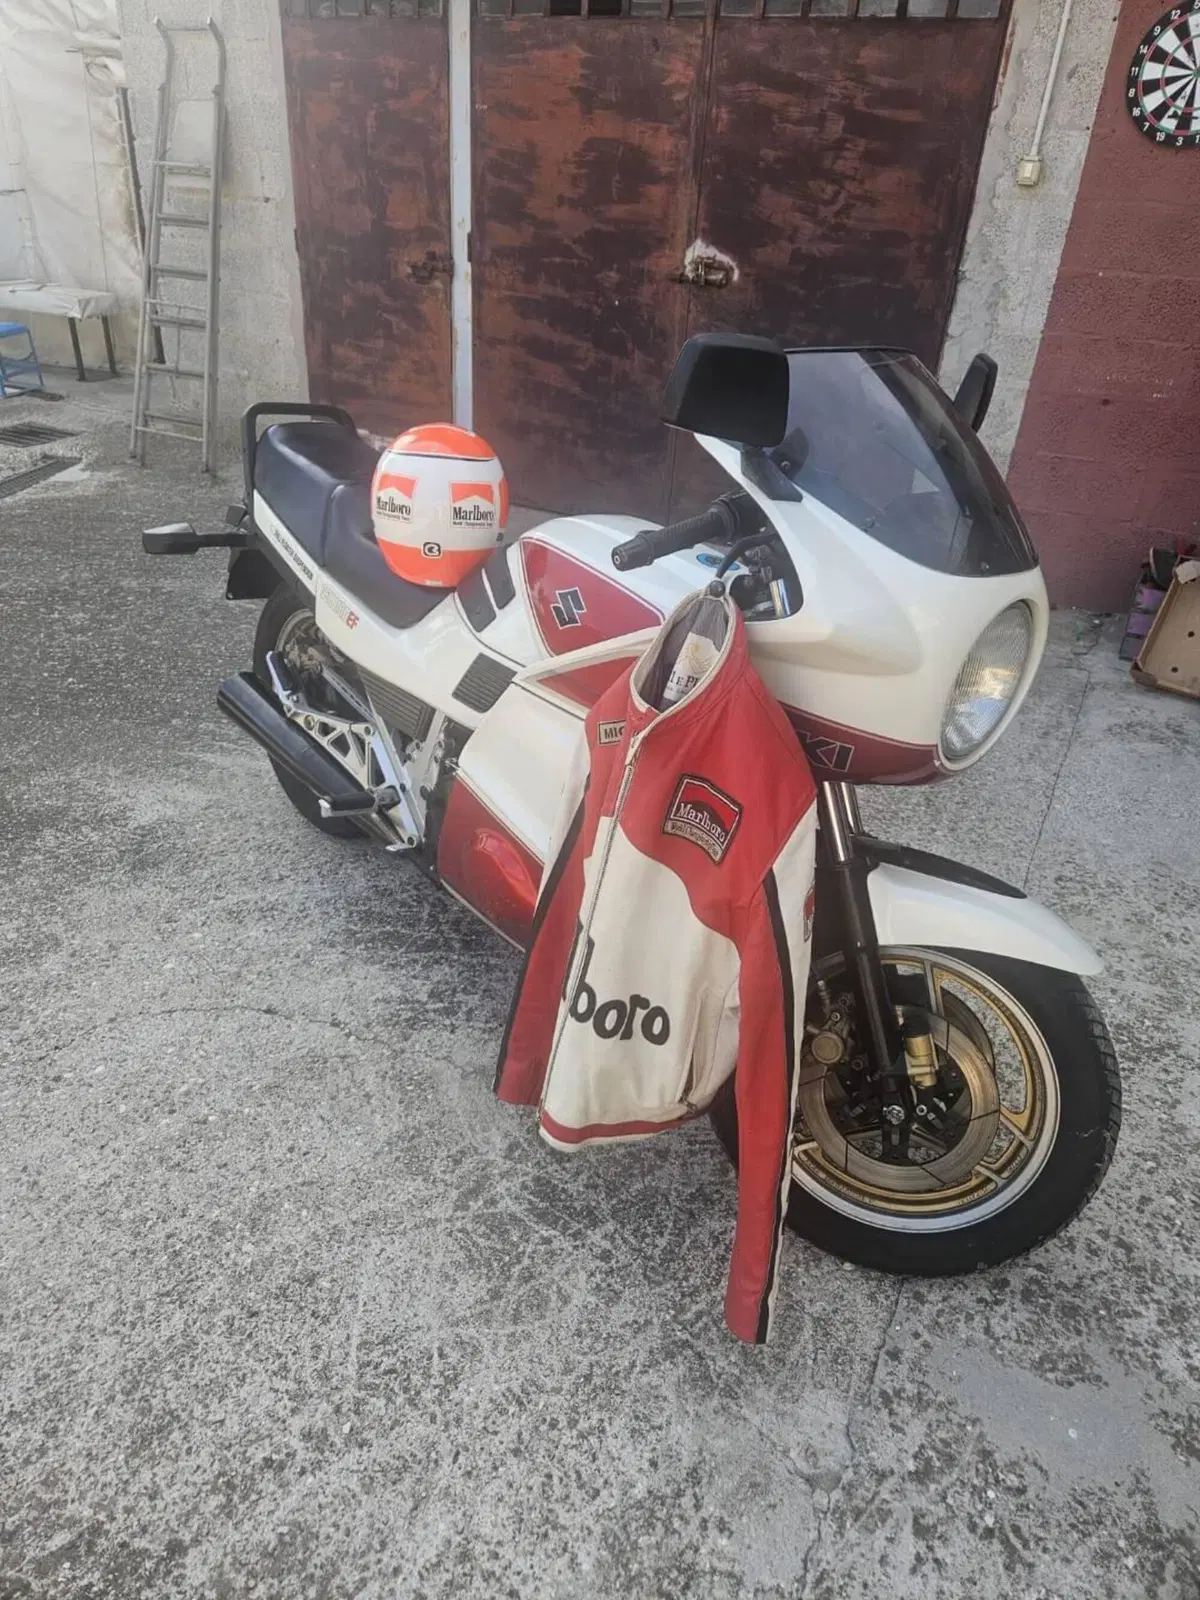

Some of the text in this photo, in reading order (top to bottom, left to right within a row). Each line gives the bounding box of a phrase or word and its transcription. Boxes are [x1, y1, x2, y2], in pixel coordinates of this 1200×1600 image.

[1171, 9, 1181, 20] 12
[1153, 25, 1161, 36] 9
[1139, 44, 1148, 55] 14
[1131, 67, 1139, 76] 11
[1128, 88, 1136, 98] 8
[1132, 106, 1141, 117] 16
[1143, 121, 1150, 131] 7
[1155, 131, 1166, 142] 19
[1176, 136, 1184, 146] 3
[452, 504, 495, 522] Marlboro
[677, 802, 726, 842] Marlboro
